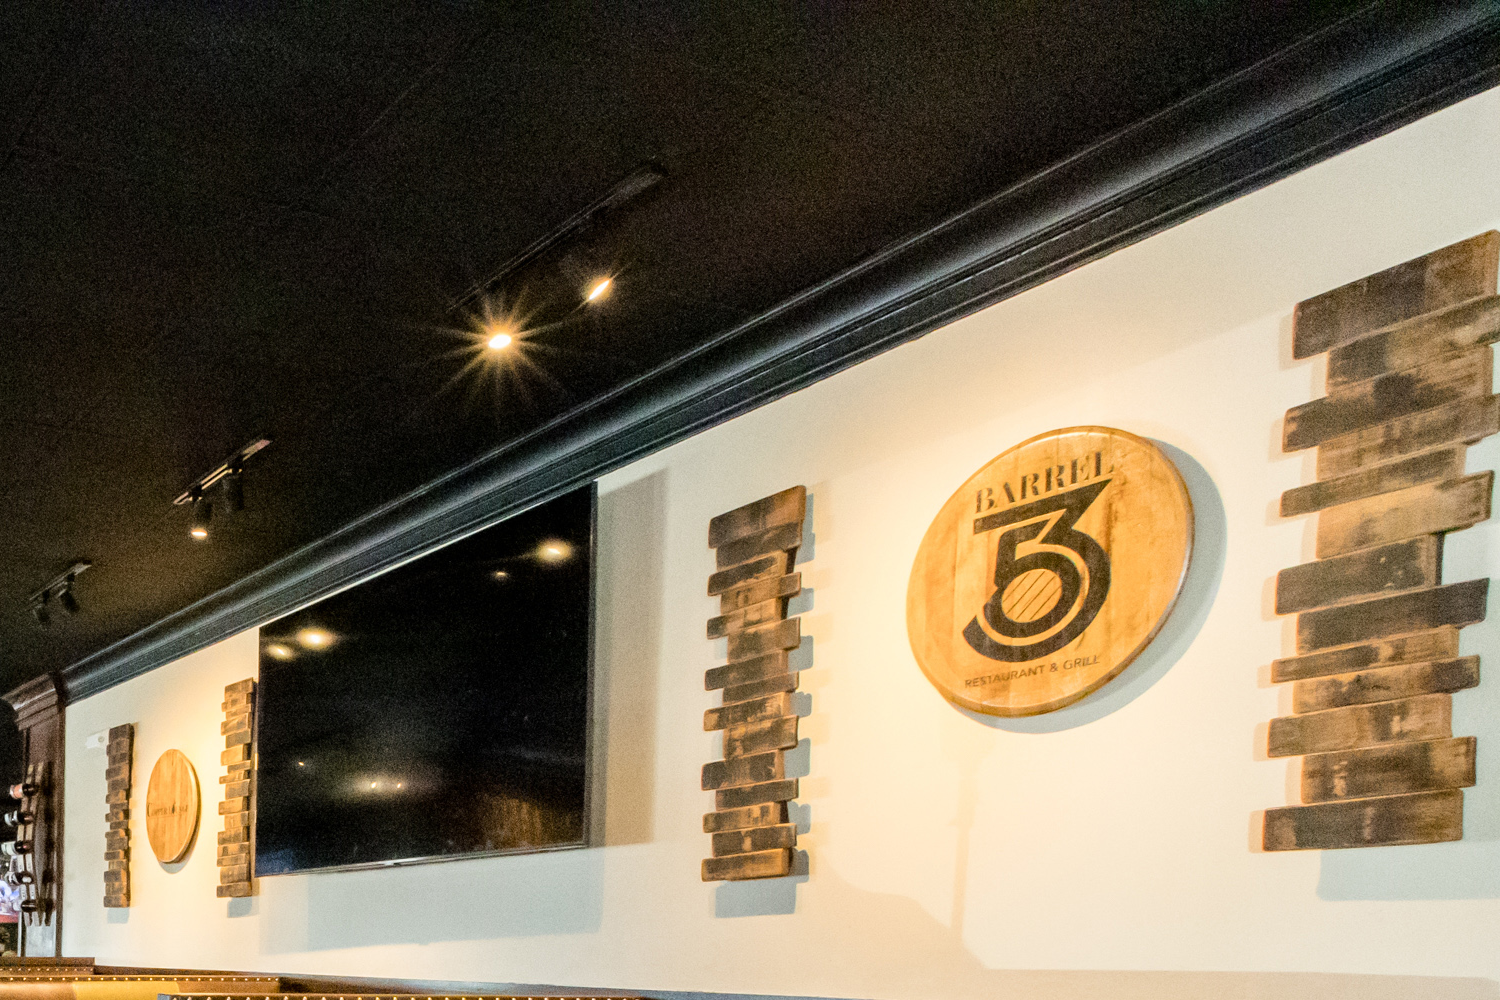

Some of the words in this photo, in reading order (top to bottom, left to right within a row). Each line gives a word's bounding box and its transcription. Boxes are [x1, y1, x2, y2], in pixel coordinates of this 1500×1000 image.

[975, 451, 1114, 513] BARREL
[964, 664, 1046, 688] RESTAURANT
[1050, 662, 1058, 672] &
[1063, 655, 1100, 669] GRILL
